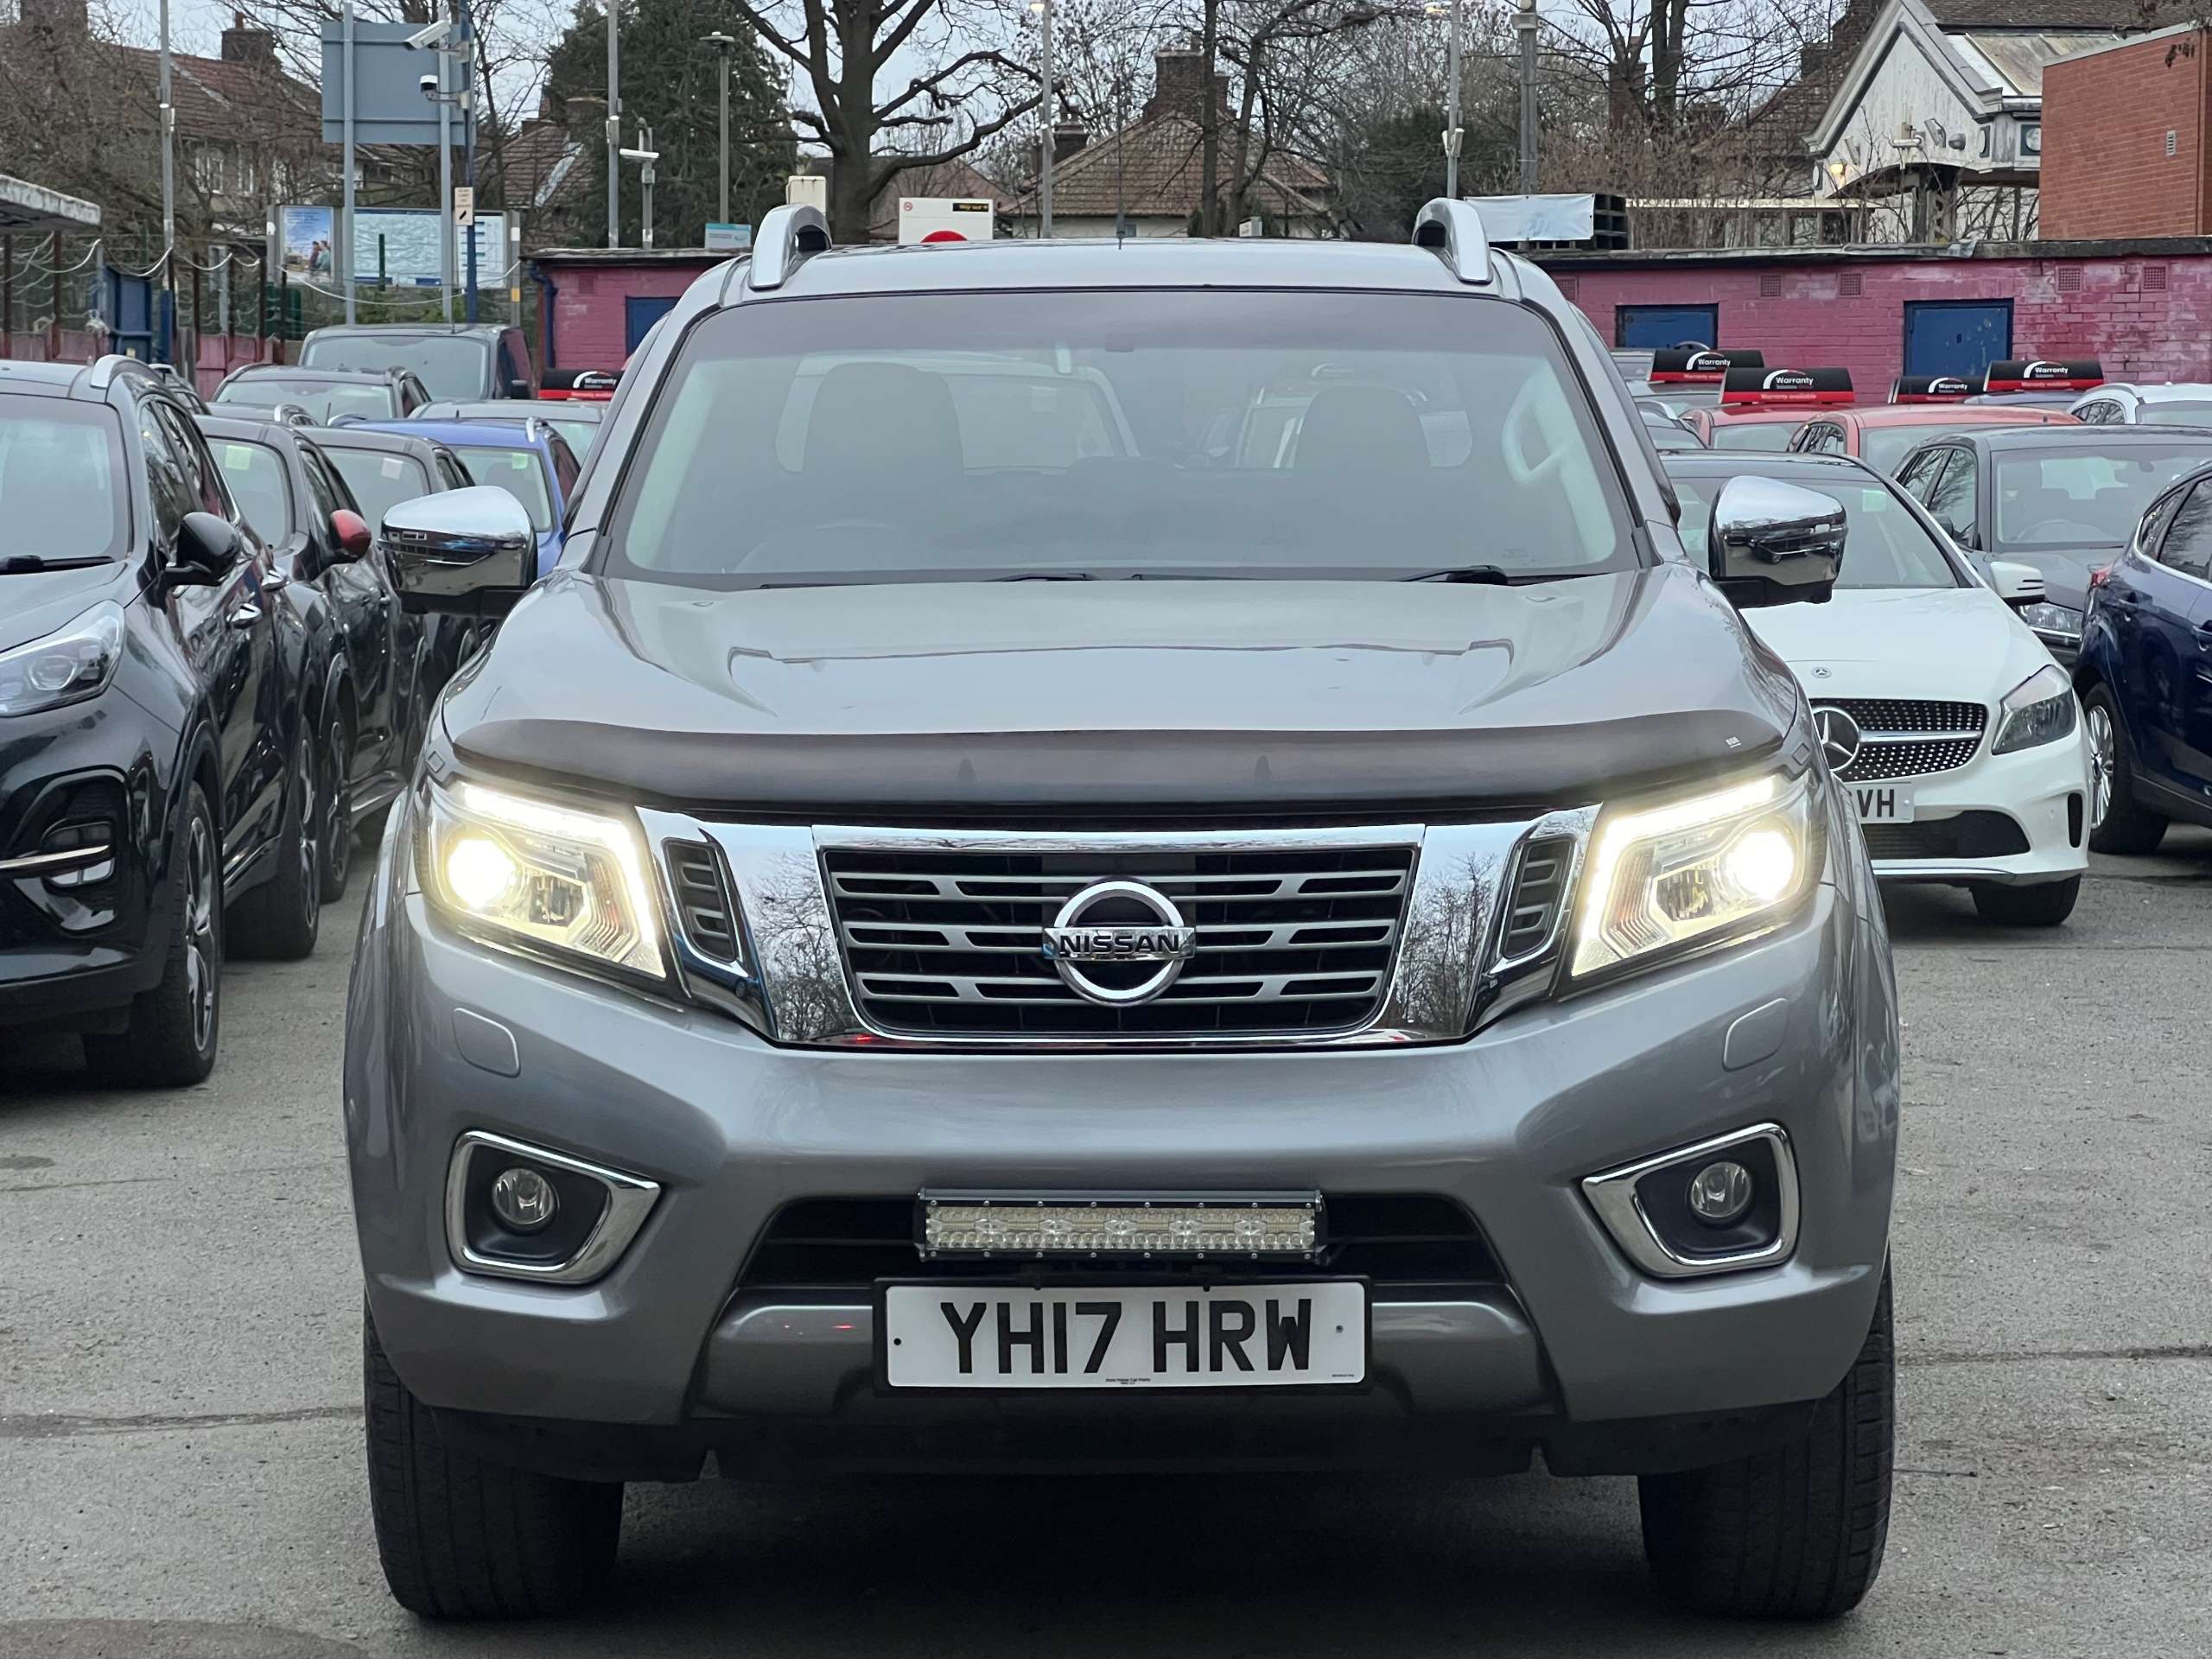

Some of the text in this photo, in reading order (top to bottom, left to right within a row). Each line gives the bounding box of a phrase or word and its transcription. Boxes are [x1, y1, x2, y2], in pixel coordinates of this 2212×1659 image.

[1697, 358, 1731, 367] Warranty
[1776, 376, 1814, 385] Warranty
[1848, 788, 1895, 818] VH
[1058, 934, 1180, 954] NISSAN
[940, 1298, 1313, 1374] YH17 HRW
